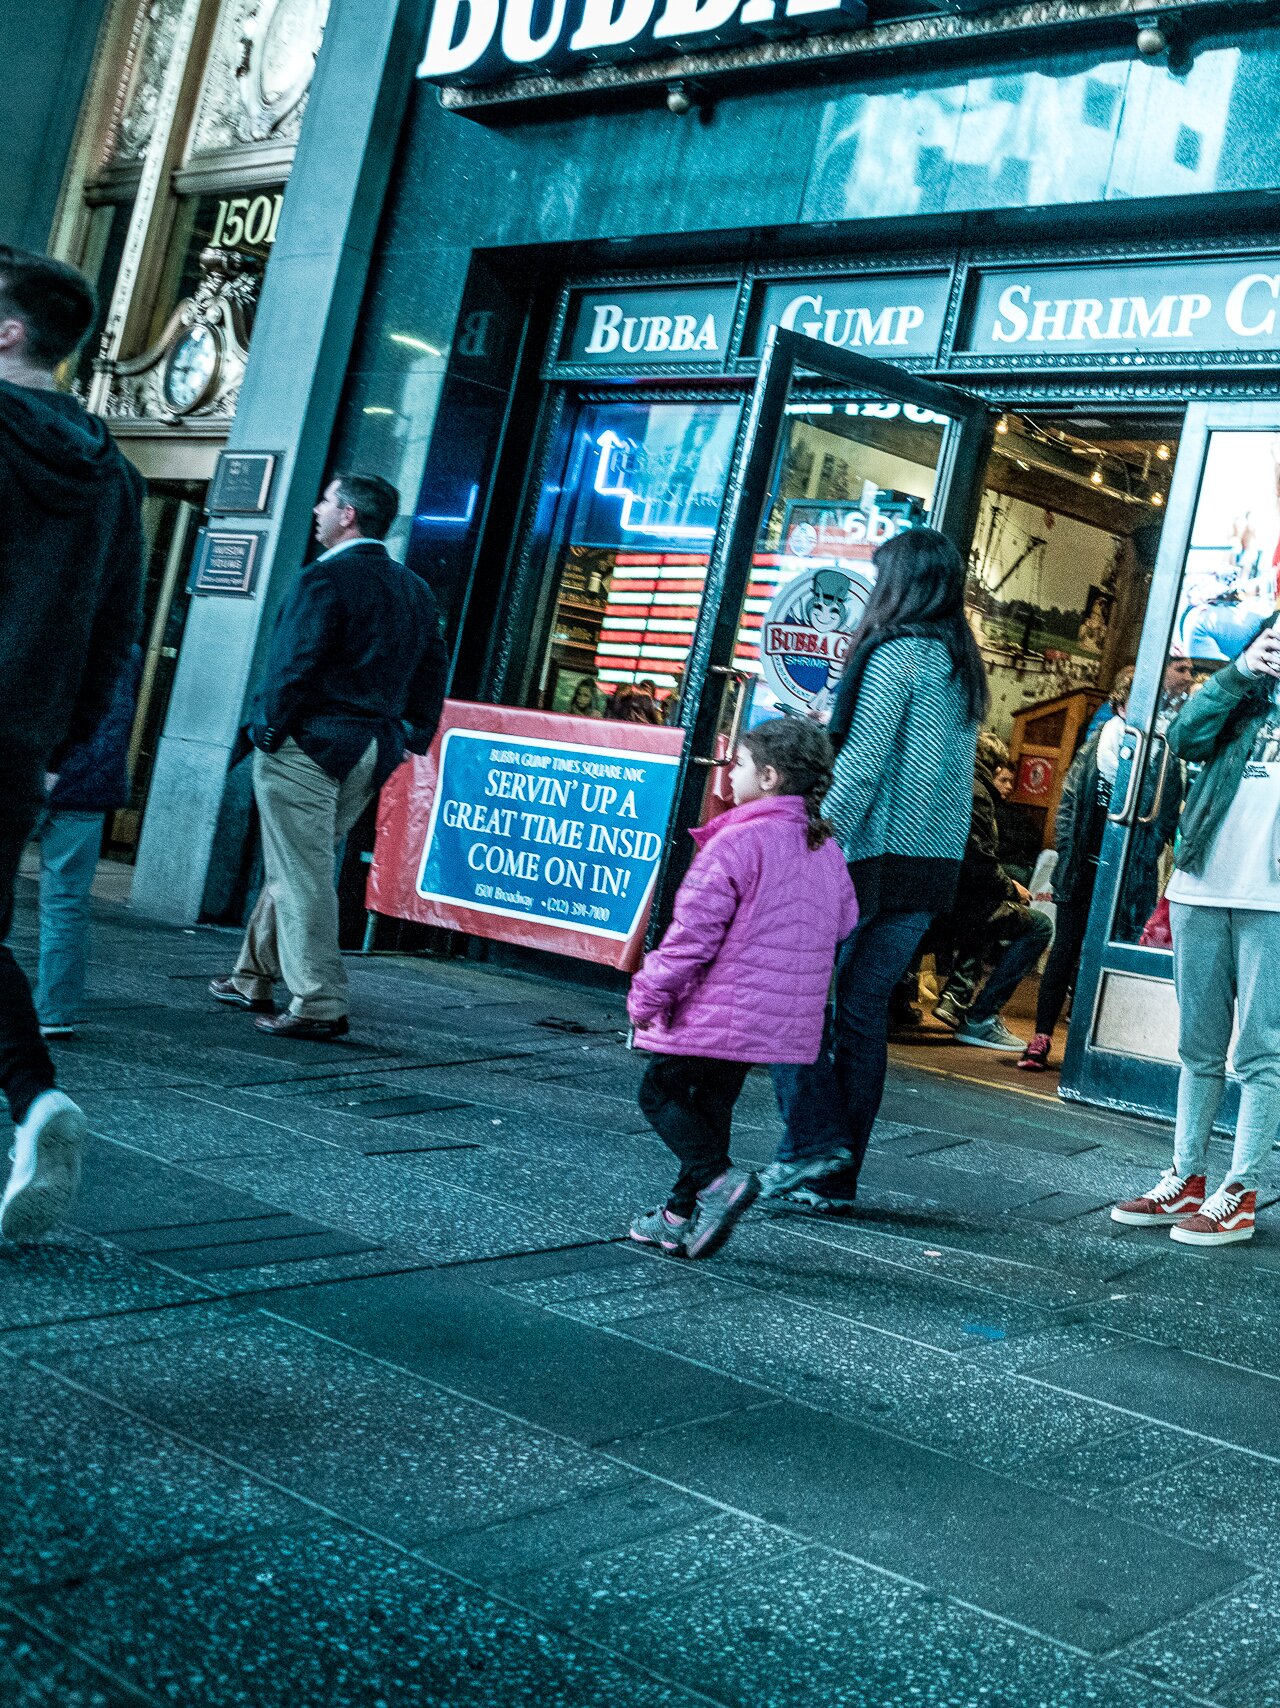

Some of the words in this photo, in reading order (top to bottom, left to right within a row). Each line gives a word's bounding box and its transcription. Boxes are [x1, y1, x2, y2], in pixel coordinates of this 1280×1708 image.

[208, 194, 284, 247] 1501
[585, 304, 718, 353] BUBBA
[780, 295, 924, 347] GUMP
[992, 285, 1211, 342] SHRIMP
[771, 628, 828, 655] BUBBA
[485, 768, 577, 808] SERVIN'
[581, 783, 618, 815] UP
[617, 789, 638, 819] A
[443, 799, 518, 837] GREAT
[520, 811, 585, 850] TIME
[468, 842, 541, 882] COME
[544, 857, 587, 890] ON
[590, 864, 632, 899] IN!
